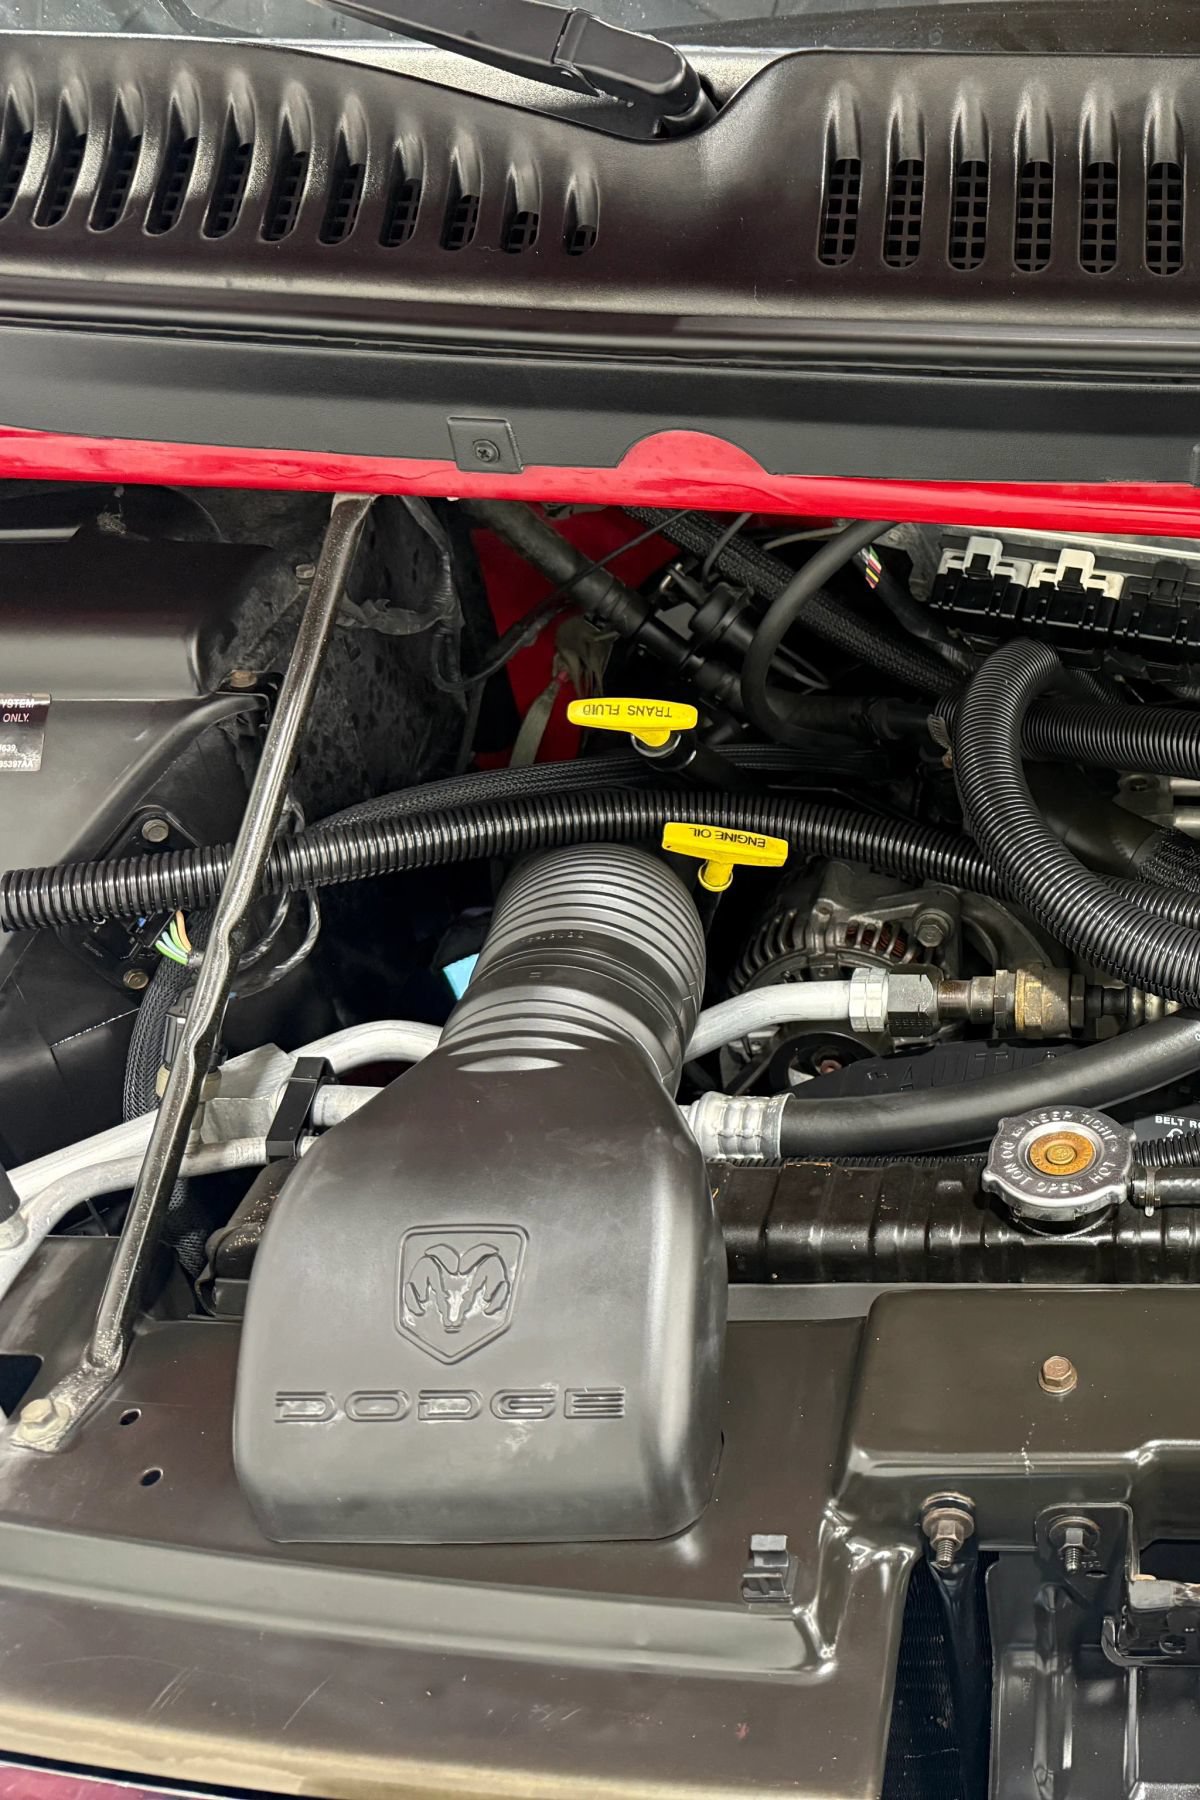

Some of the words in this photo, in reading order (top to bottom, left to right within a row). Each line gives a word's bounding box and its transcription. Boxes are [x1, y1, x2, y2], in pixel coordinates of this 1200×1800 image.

[582, 703, 621, 716] FLUID
[627, 704, 672, 718] TRANS
[3, 713, 30, 723] ONLY.
[689, 827, 712, 839] OIL
[714, 830, 766, 848] ENGINE
[1026, 1110, 1074, 1127] KEEP
[1079, 1113, 1118, 1141] TIGHT
[1154, 1115, 1185, 1127] BELT
[1000, 1140, 1015, 1160] DO
[1003, 1162, 1033, 1186] NOT
[1088, 1161, 1117, 1184] HOT
[1036, 1181, 1084, 1195] OPEN
[274, 1388, 625, 1423] DODGE
